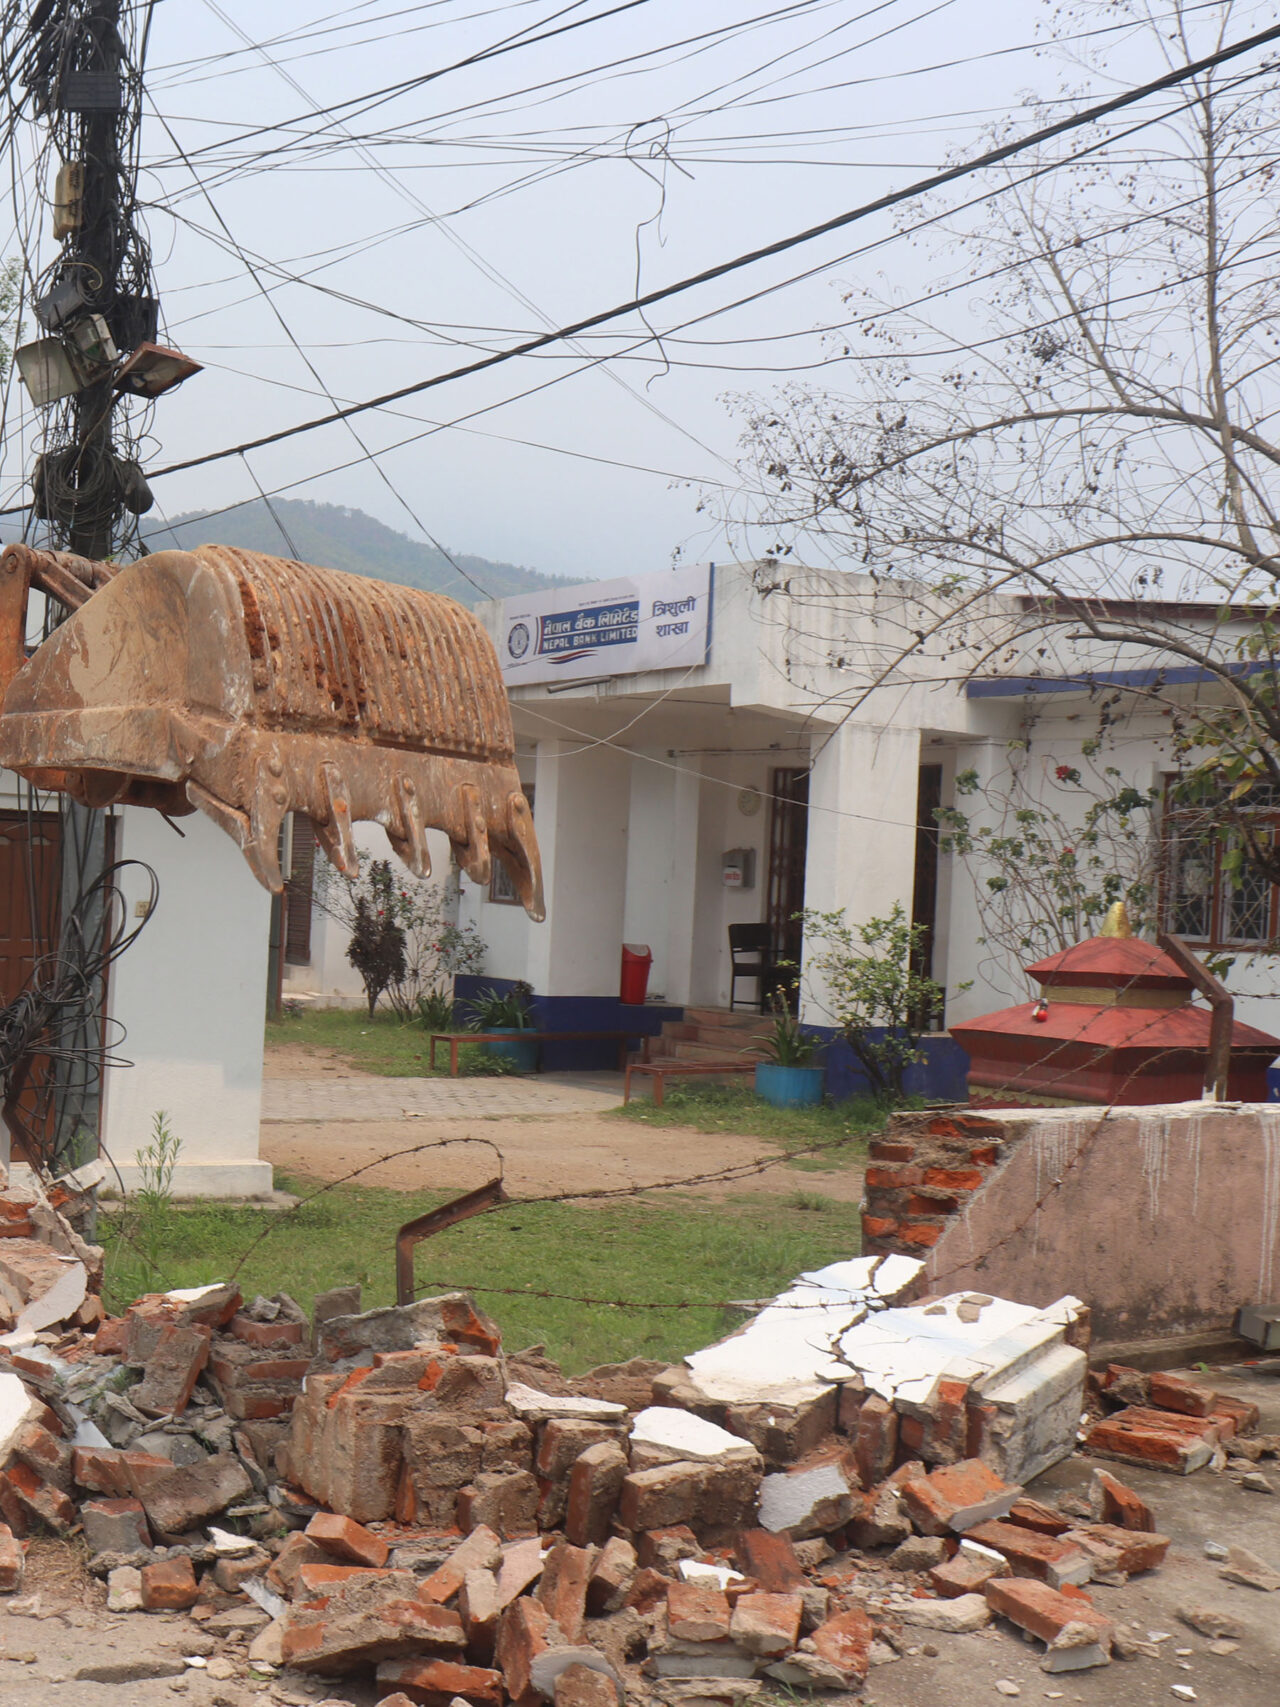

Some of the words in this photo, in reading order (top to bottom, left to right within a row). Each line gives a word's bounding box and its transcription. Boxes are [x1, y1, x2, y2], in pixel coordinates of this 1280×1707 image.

[652, 595, 696, 617] त्रिशुली
[544, 619, 572, 635] नेपाल
[656, 621, 690, 638] शाखा
[543, 637, 570, 650] NEPAL
[573, 633, 598, 646] BANK
[600, 627, 638, 642] LIMITED
